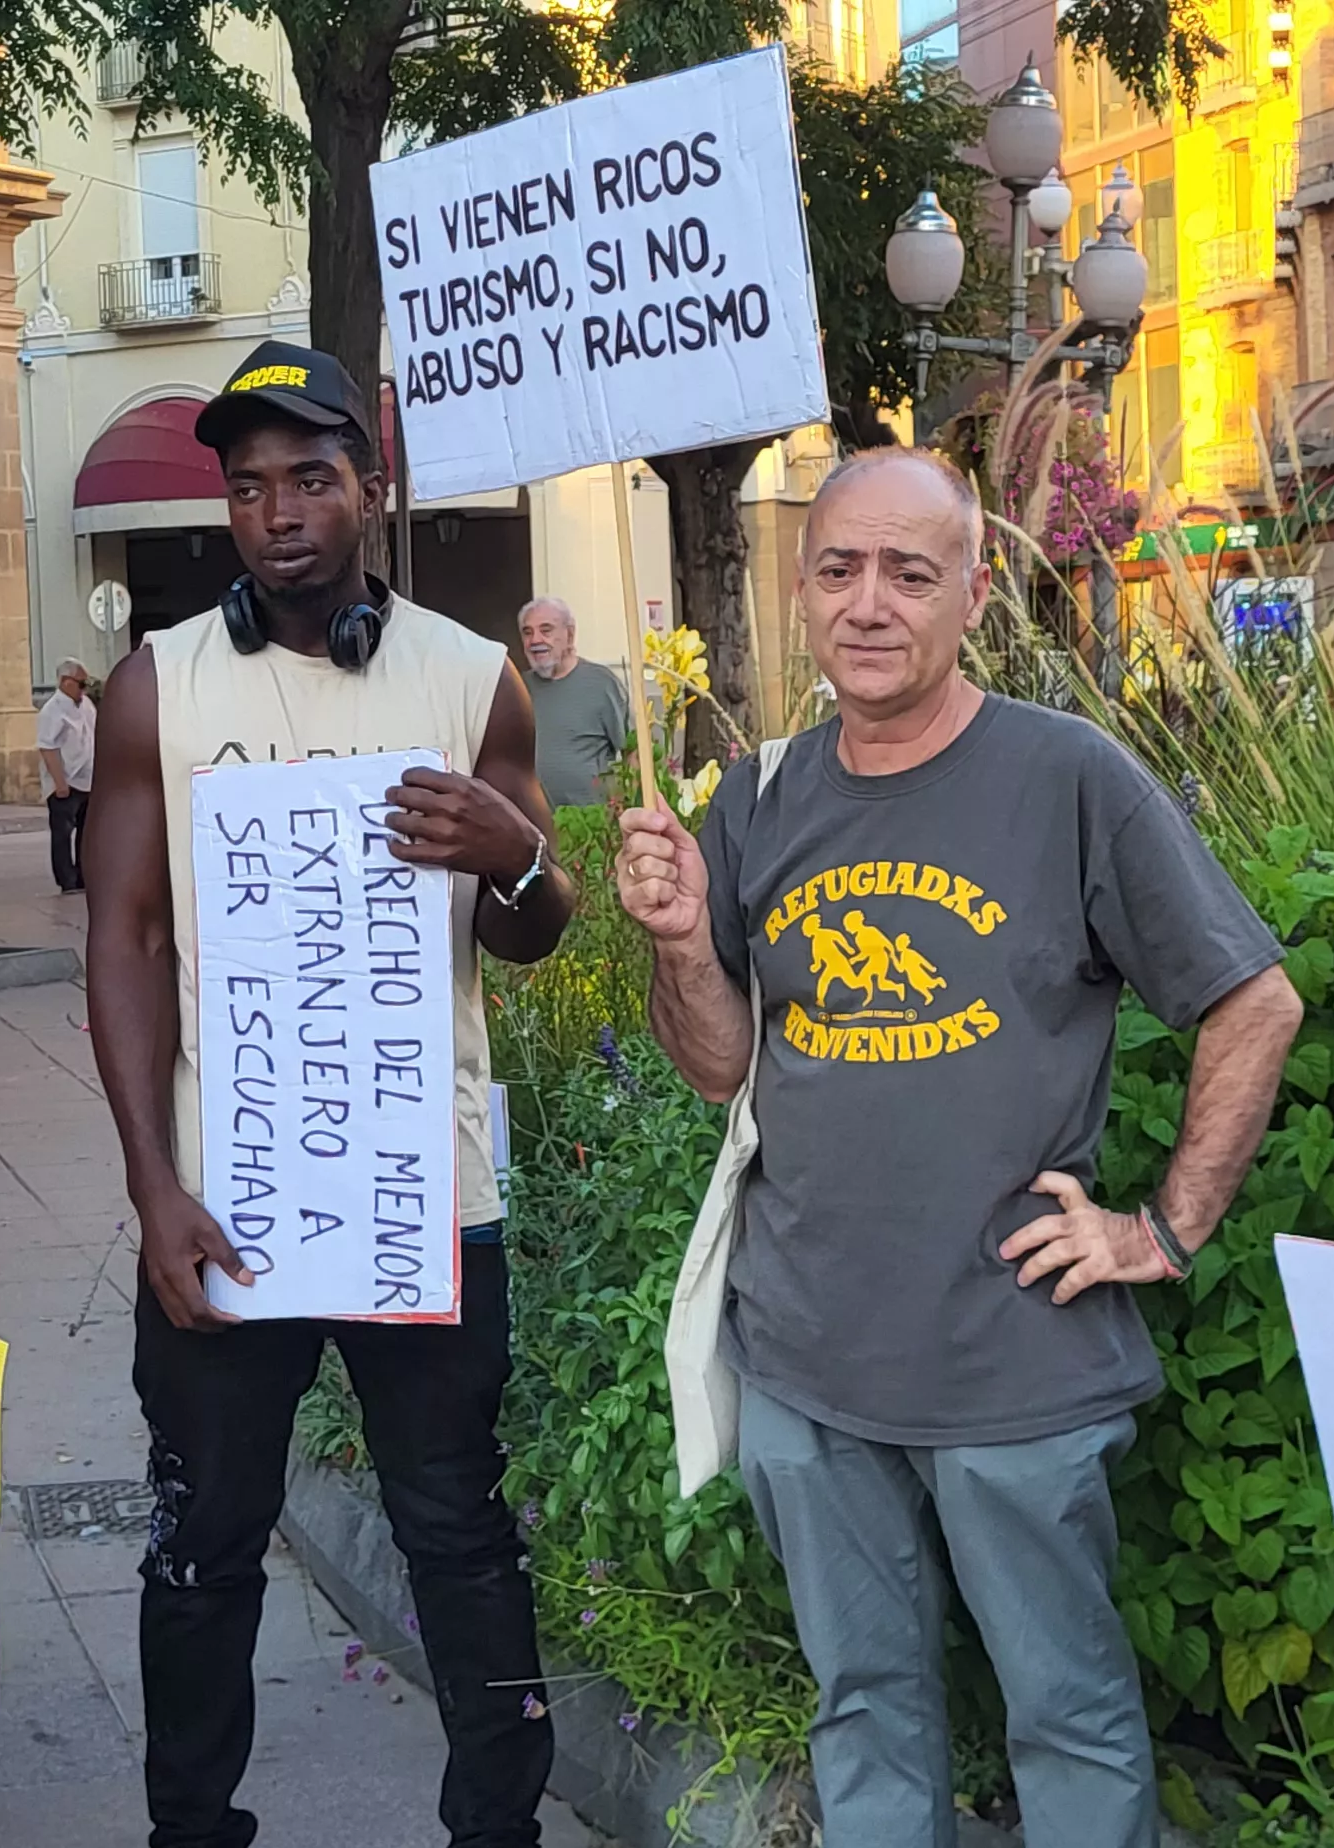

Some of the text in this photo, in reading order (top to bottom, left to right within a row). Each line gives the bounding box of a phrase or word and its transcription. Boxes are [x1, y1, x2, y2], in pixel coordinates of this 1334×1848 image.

[385, 131, 721, 269] SI VIENEN RICOS
[398, 216, 726, 342] TURISMO, SI NO,
[405, 282, 770, 408] ABUSO Y RACISMO
[764, 861, 1008, 946] REFUGIADXS
[215, 811, 278, 1276] SER ESCUCHADO
[289, 808, 350, 1245] EXTRANJERO A
[373, 1038, 423, 1109] DEL
[373, 1150, 425, 1309] MENOR
